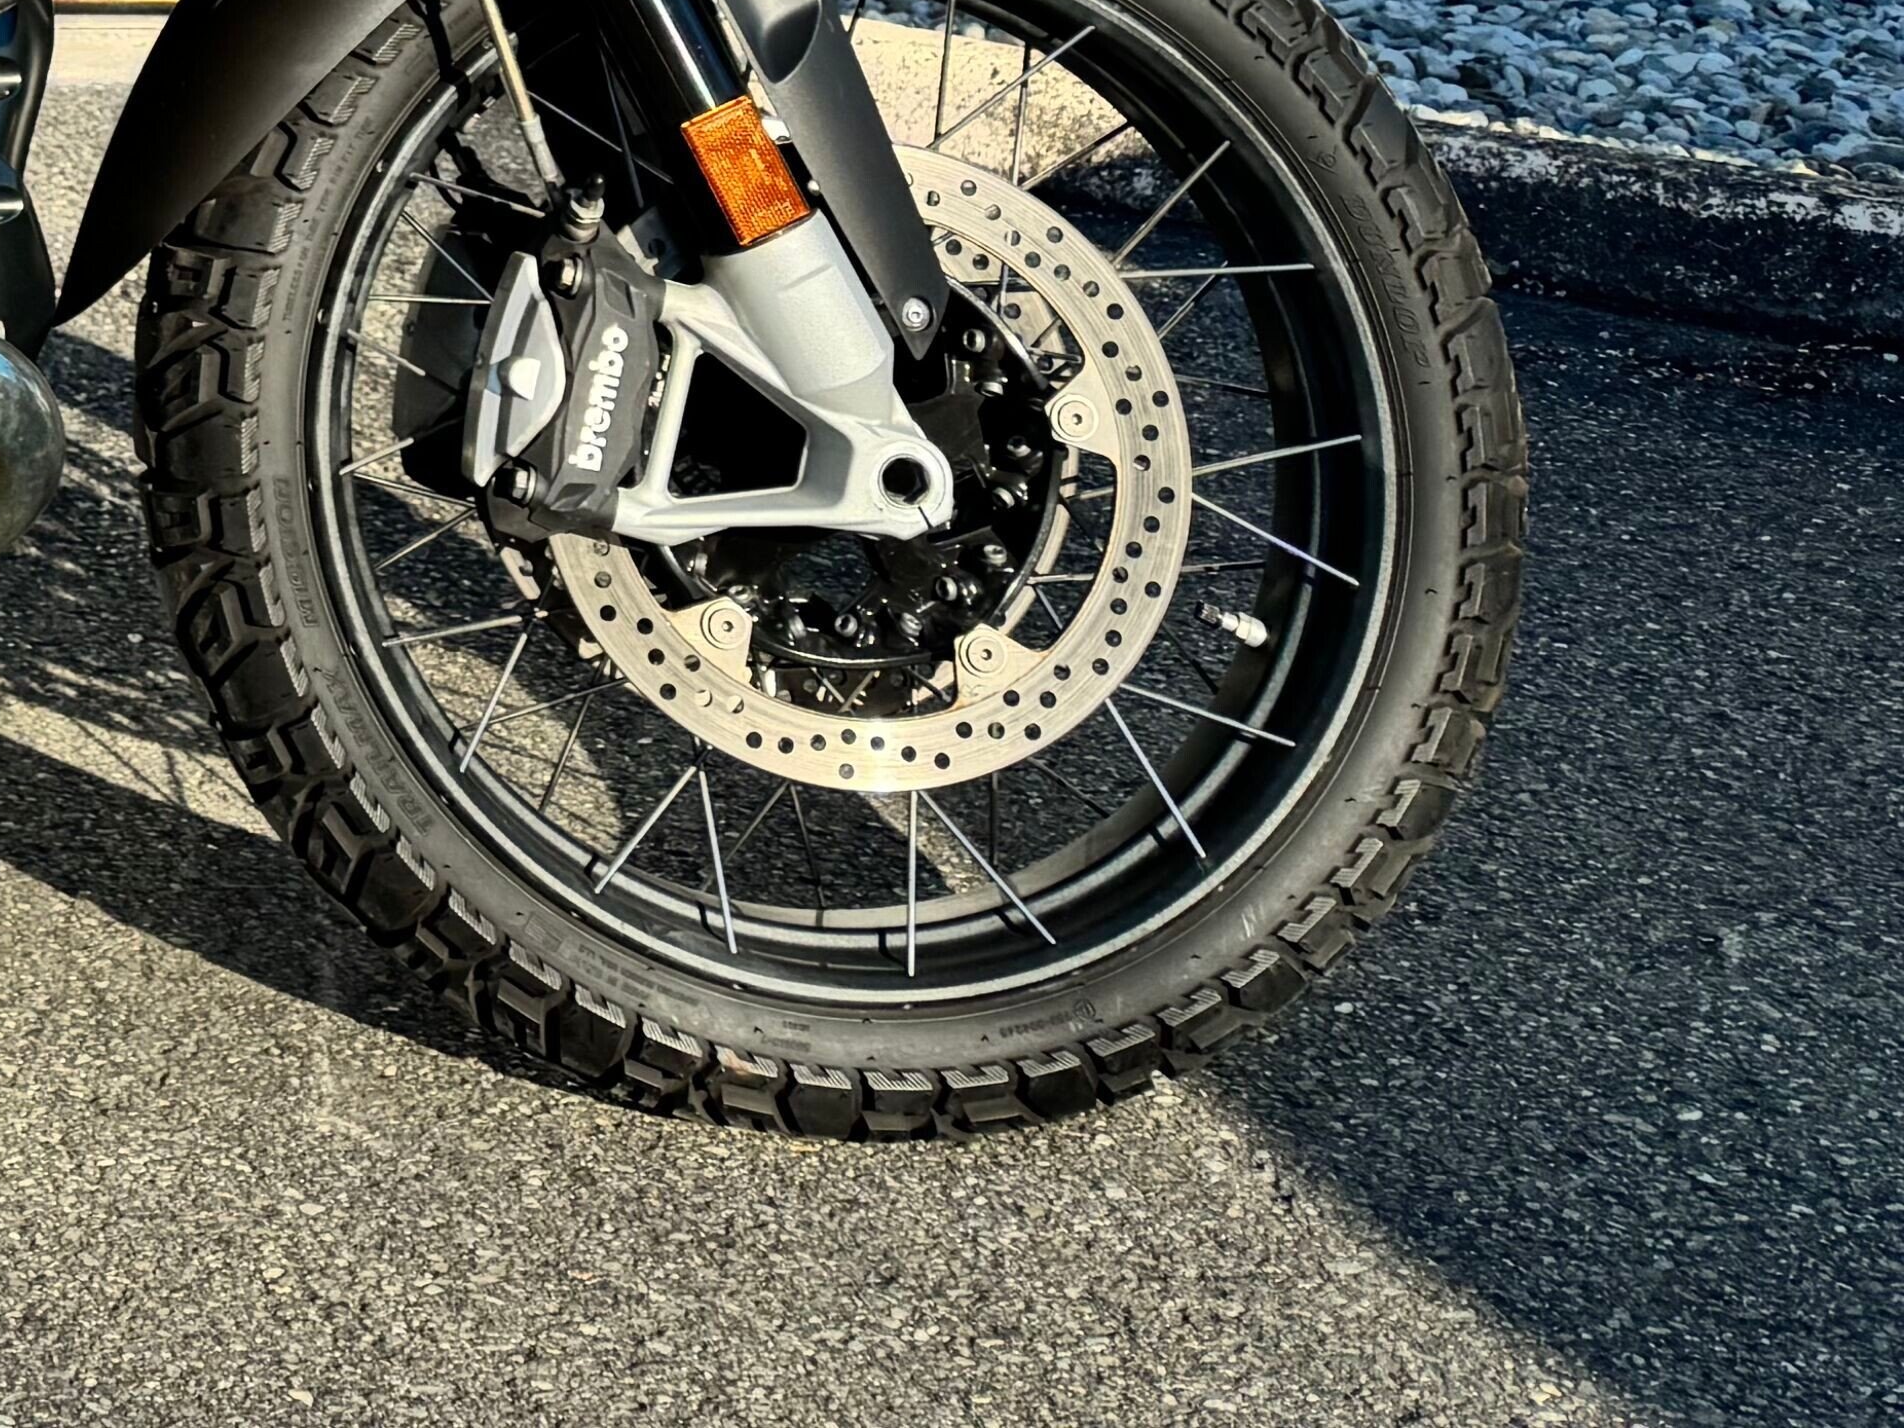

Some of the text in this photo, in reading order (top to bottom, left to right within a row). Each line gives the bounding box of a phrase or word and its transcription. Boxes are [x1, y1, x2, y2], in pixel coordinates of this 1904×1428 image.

[1338, 194, 1431, 370] DUNLOP
[568, 323, 630, 473] brembo
[319, 667, 435, 838] TRAILMAX
